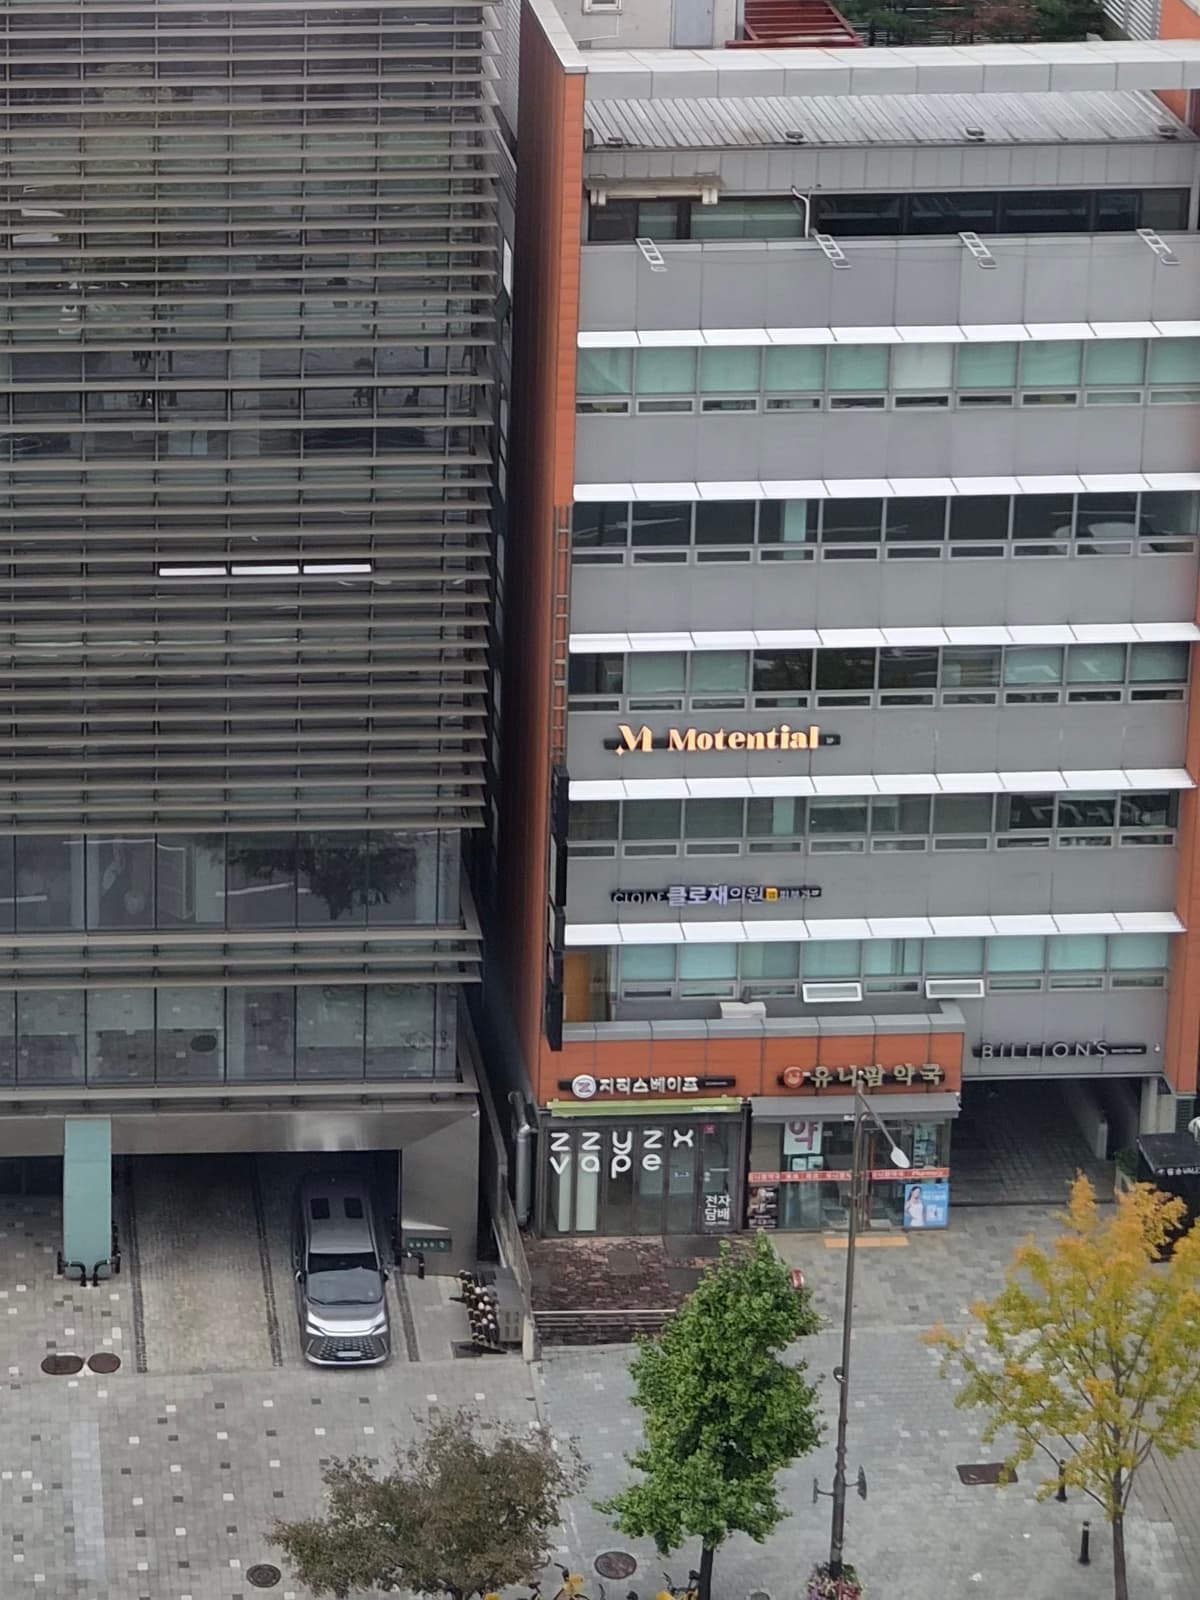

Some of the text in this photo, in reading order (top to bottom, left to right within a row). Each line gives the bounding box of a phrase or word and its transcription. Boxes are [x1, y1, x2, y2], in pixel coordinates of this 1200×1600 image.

[667, 725, 821, 751] Motential
[982, 1041, 1108, 1059] BILLIONS
[550, 1154, 661, 1179] vape
[705, 1195, 731, 1209] 전자
[705, 1208, 730, 1221] 담배
